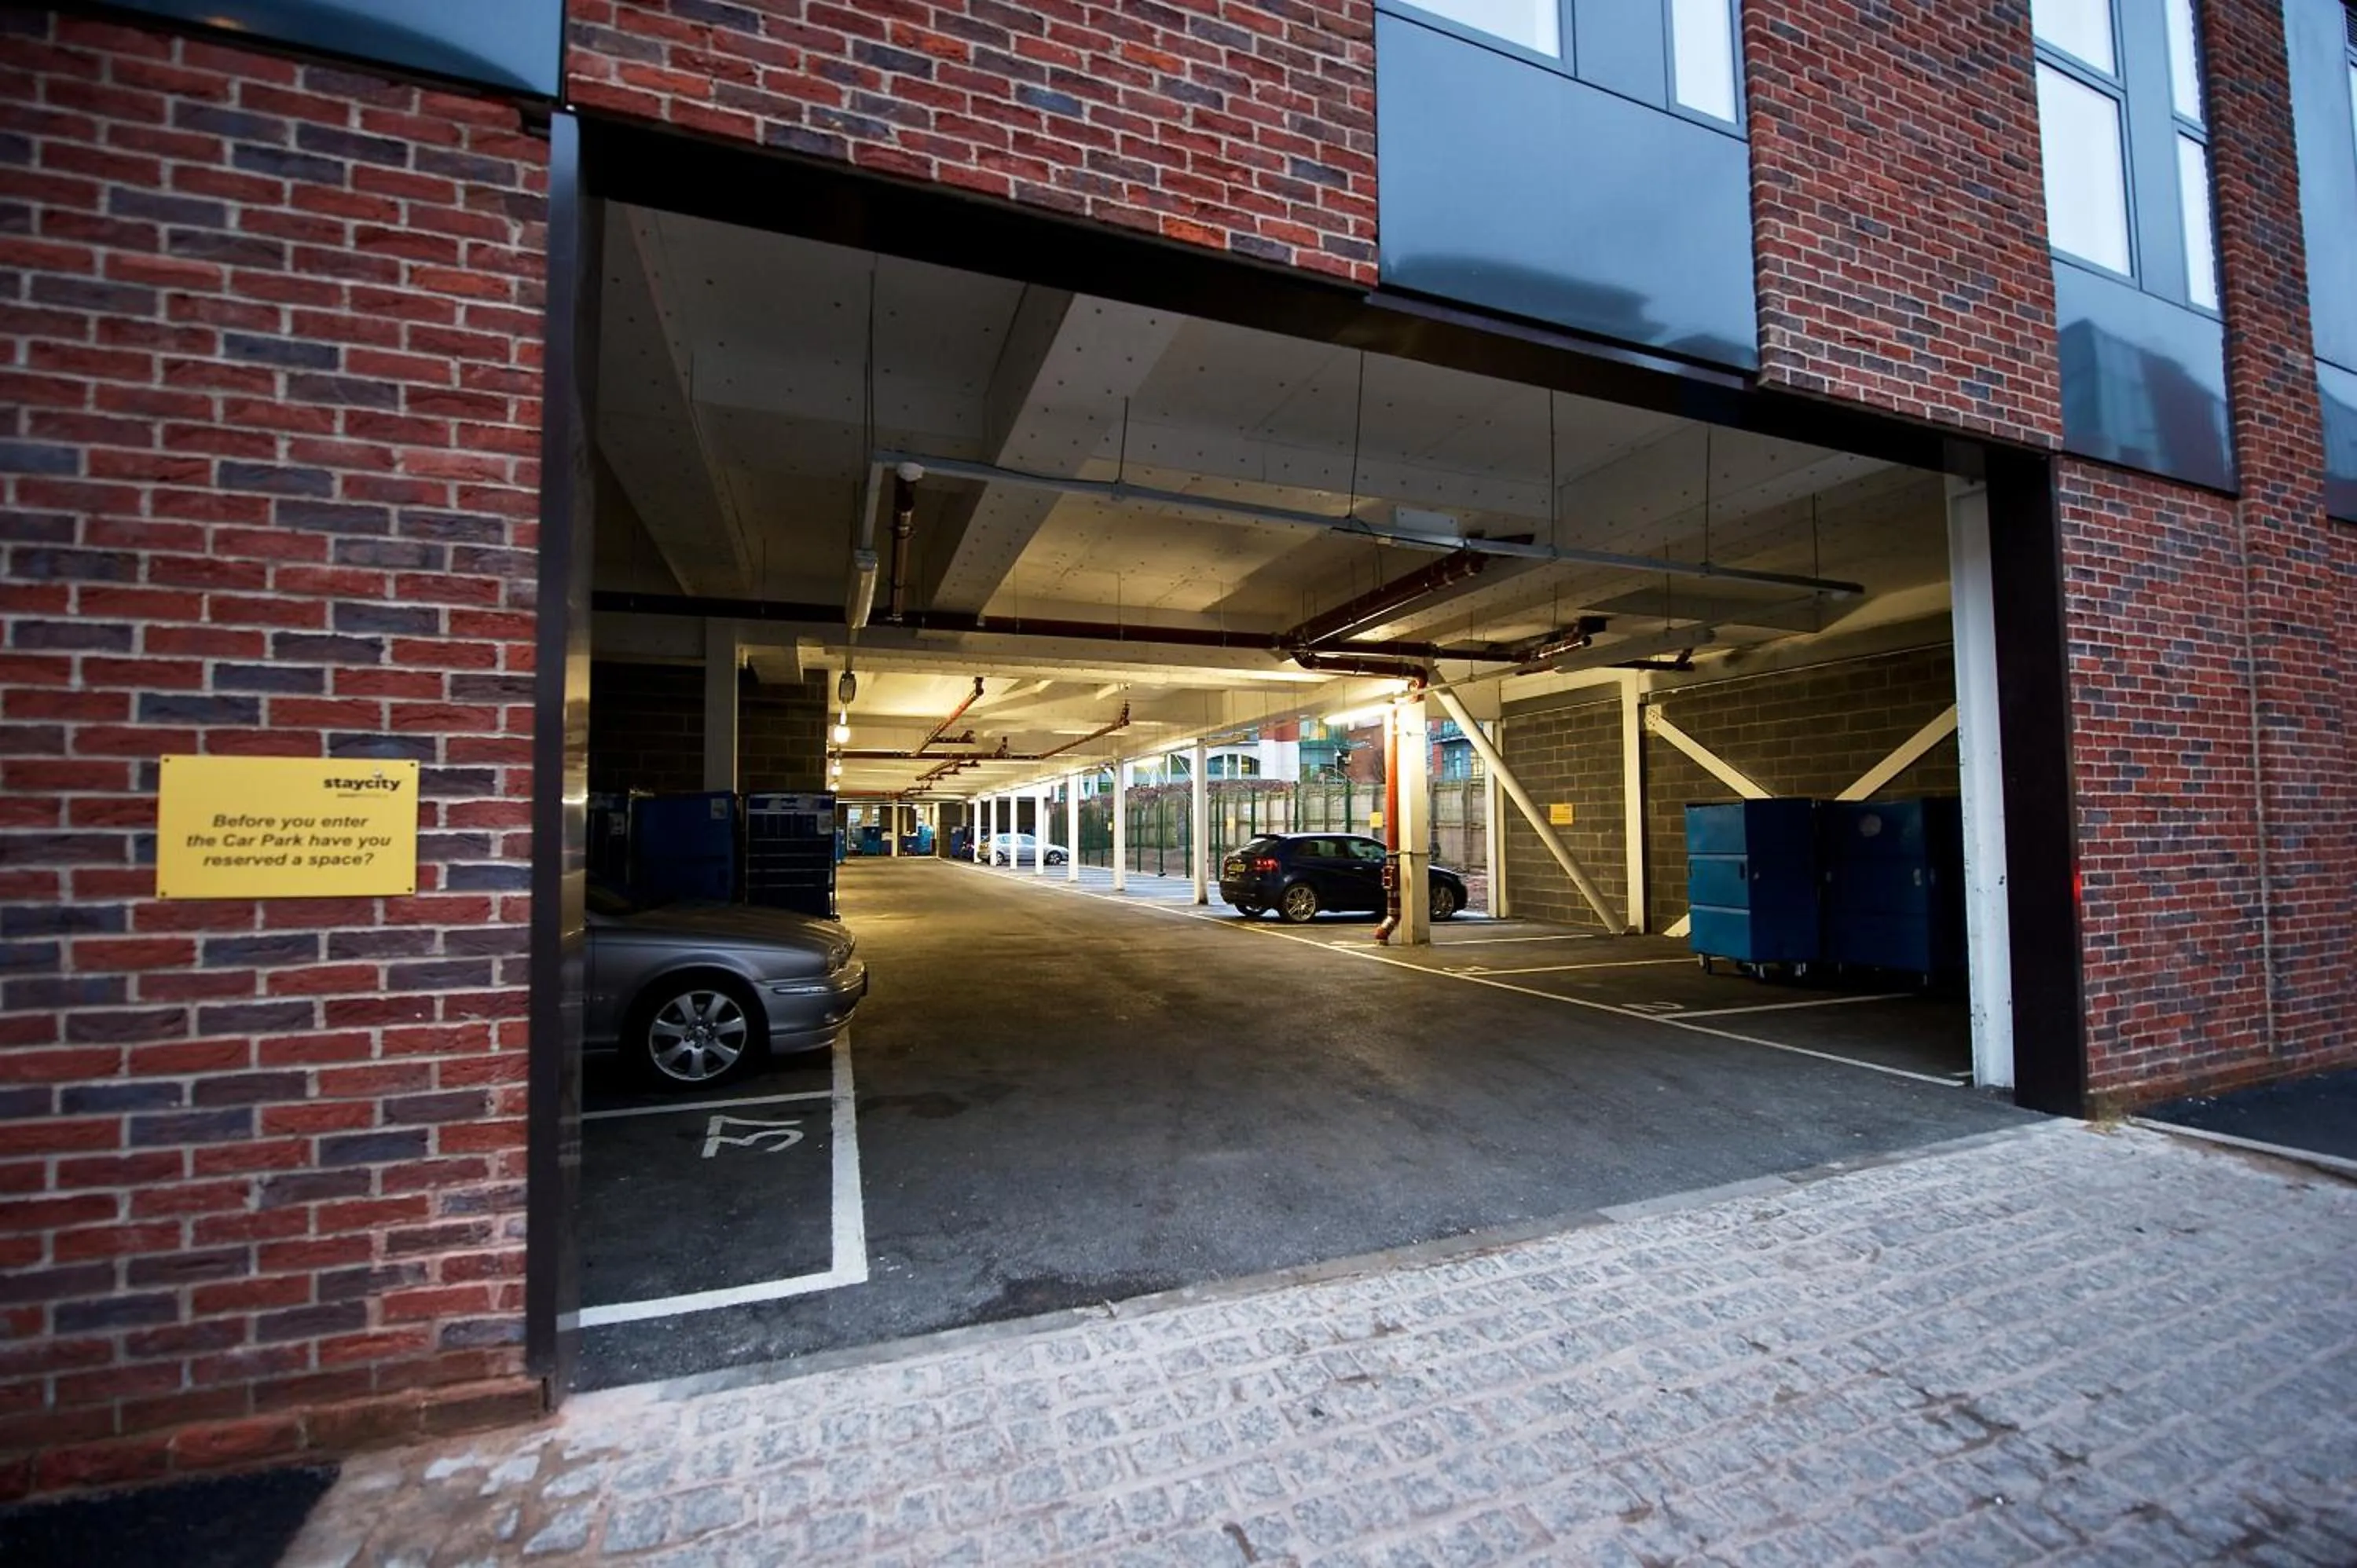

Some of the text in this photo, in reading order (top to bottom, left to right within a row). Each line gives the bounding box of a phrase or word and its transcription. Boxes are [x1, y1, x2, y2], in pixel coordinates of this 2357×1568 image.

[323, 776, 401, 792] staycity
[213, 814, 369, 830] Before you enter
[186, 833, 391, 849] the Car Park have you
[203, 852, 375, 868] reserved a space?
